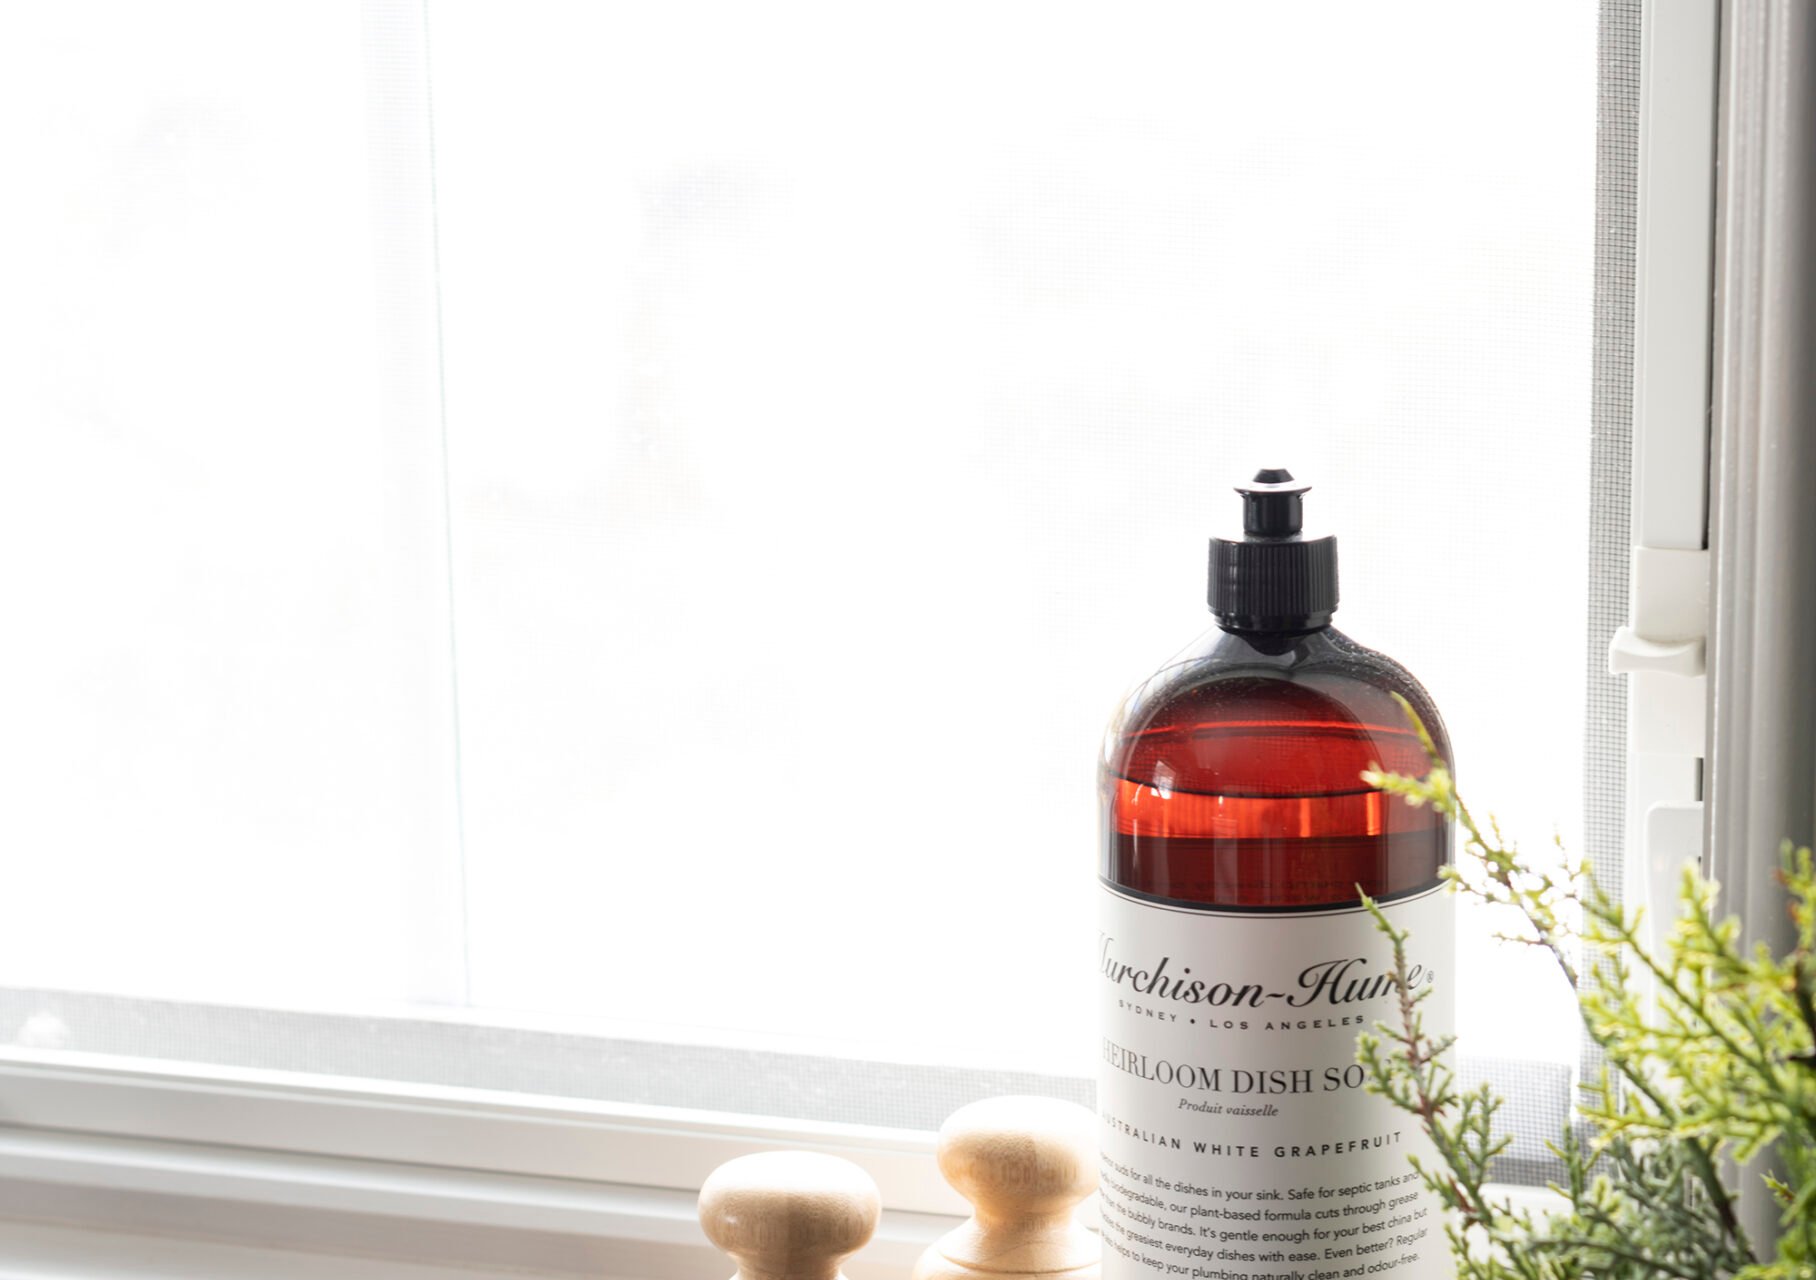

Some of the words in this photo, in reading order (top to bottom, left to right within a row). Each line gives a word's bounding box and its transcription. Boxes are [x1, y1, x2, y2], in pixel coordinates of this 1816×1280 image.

[1118, 1000, 1177, 1022] SYDNEY
[1210, 1019, 1249, 1030] LOS
[1265, 1015, 1364, 1031] ANGELES
[1102, 1036, 1223, 1093] HEIRLOOM
[1231, 1069, 1313, 1095] DISH
[1178, 1098, 1223, 1114] Produit
[1226, 1103, 1279, 1117] vaisselle
[1193, 1141, 1259, 1158] WHITE
[1274, 1131, 1400, 1158] GRAPEFRUIT
[1130, 1168, 1141, 1181] for
[1143, 1174, 1153, 1186] all
[1155, 1177, 1171, 1190] the
[1174, 1181, 1208, 1197] dishes
[1212, 1186, 1222, 1198] in
[1225, 1189, 1252, 1202] your
[1256, 1189, 1284, 1201] sink.
[1288, 1188, 1315, 1201] Safe
[1318, 1186, 1335, 1199] for
[1338, 1182, 1372, 1198] septic
[1374, 1176, 1401, 1190] tanks
[1402, 1170, 1420, 1183] and
[1169, 1203, 1188, 1214] our
[1190, 1205, 1261, 1221] plant-based
[1265, 1209, 1312, 1222] formula
[1315, 1207, 1340, 1220] cuts
[1343, 1200, 1386, 1217] through
[1388, 1191, 1419, 1210] grease
[1128, 1208, 1156, 1229] bubbly
[1158, 1217, 1196, 1236] brands.
[1200, 1226, 1216, 1239] It's
[1219, 1230, 1258, 1243] gentle
[1262, 1230, 1310, 1245] enough
[1313, 1228, 1330, 1240] for
[1333, 1226, 1360, 1241] your
[1362, 1221, 1386, 1234] best
[1387, 1213, 1412, 1229] china
[1413, 1206, 1428, 1220] but
[1126, 1229, 1163, 1249] greasiest
[1165, 1242, 1214, 1261] everyday
[1216, 1248, 1256, 1262] dishes
[1259, 1250, 1285, 1263] with
[1288, 1252, 1321, 1263] ease.
[1324, 1248, 1353, 1260] Even
[1356, 1237, 1394, 1256] better?
[1396, 1226, 1428, 1248] Regular
[1132, 1249, 1141, 1262] to
[1142, 1252, 1164, 1272] keep
[1166, 1261, 1190, 1275] your
[1342, 1264, 1365, 1278] and
[1367, 1252, 1421, 1274] odour-free.
